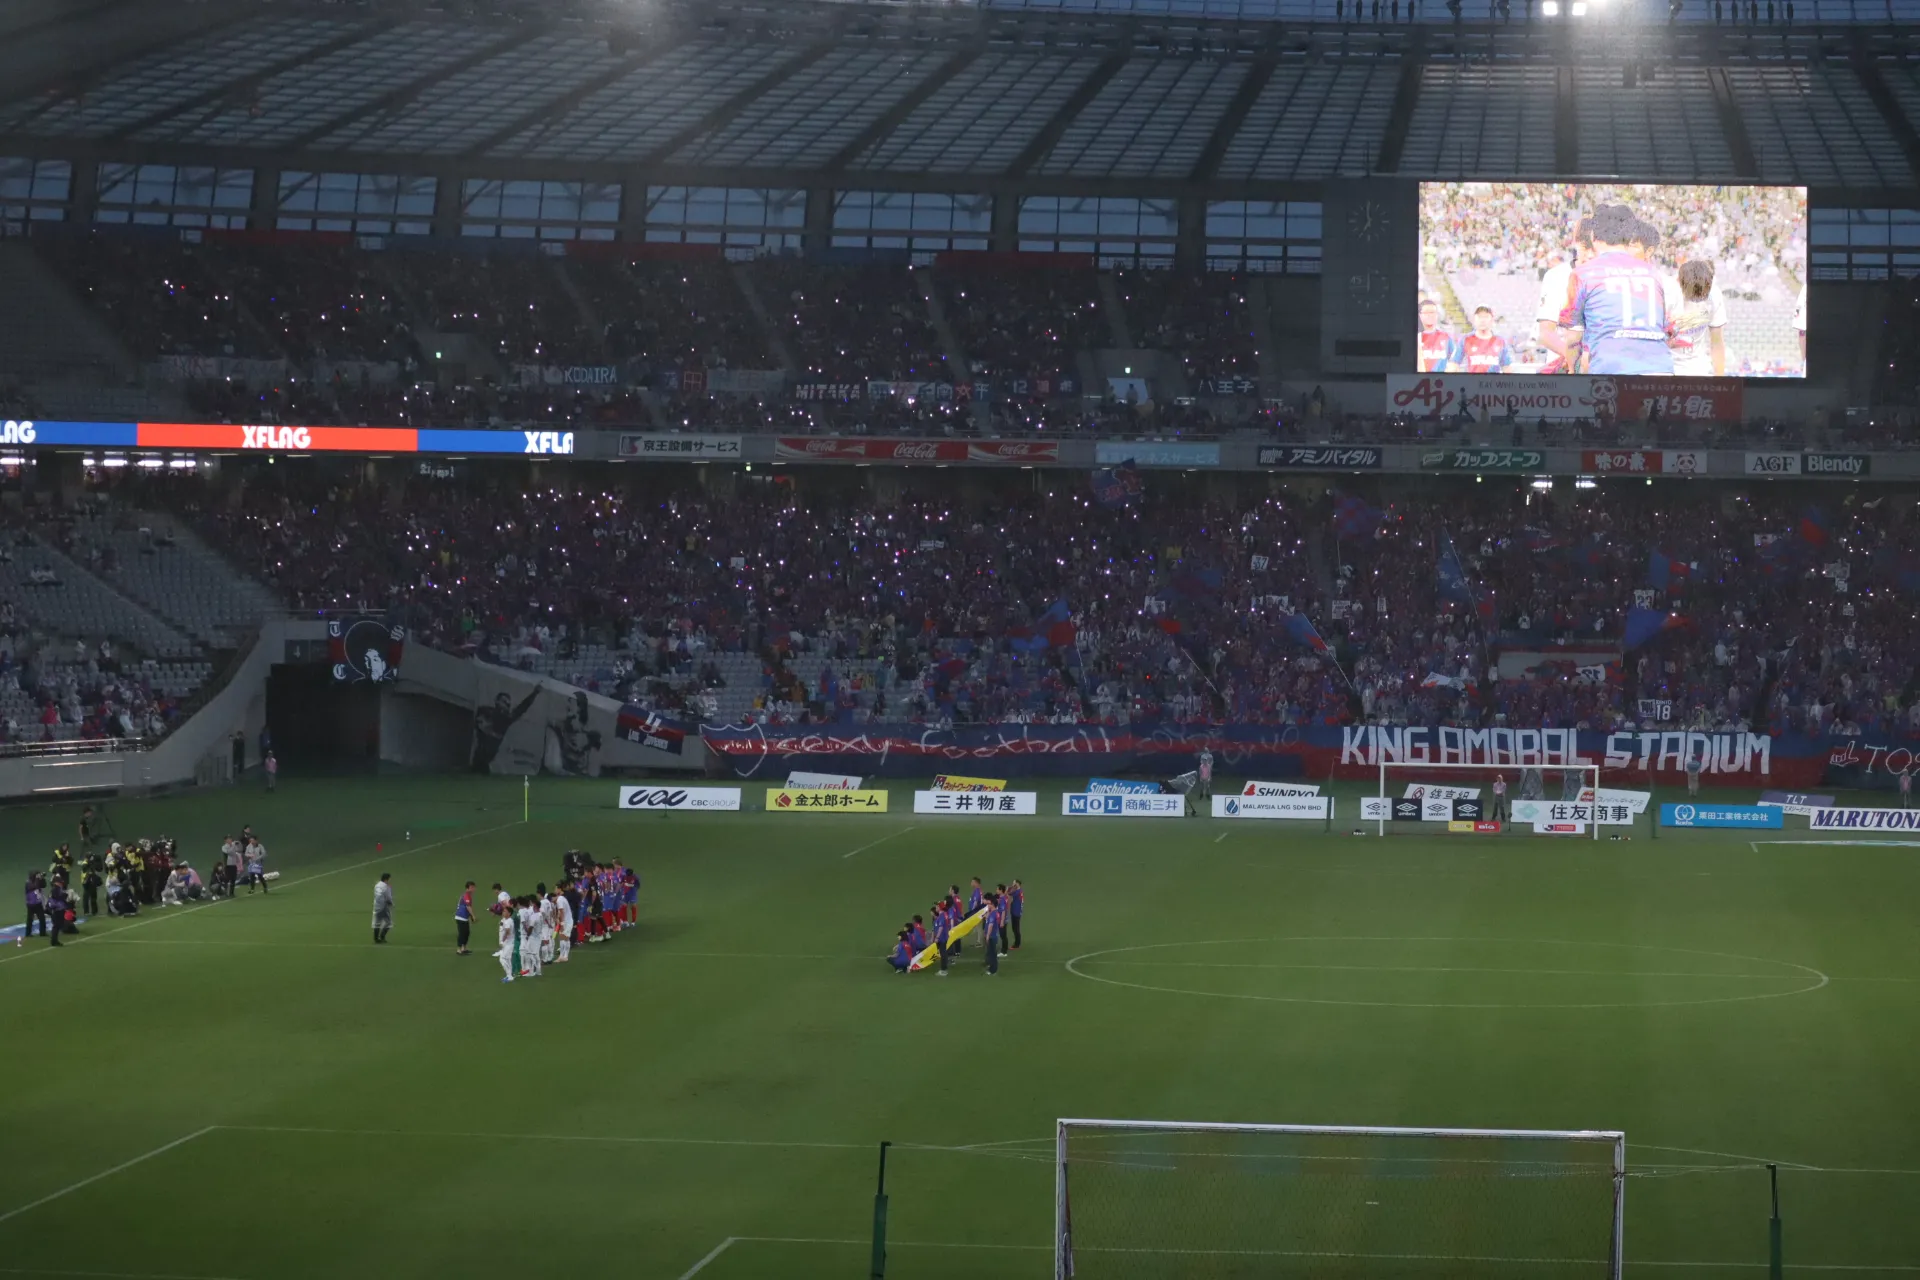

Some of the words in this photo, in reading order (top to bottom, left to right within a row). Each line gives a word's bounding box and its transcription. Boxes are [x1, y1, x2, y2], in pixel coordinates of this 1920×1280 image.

[564, 365, 617, 384] KODAIRA
[242, 425, 311, 449] XFLAG
[643, 440, 739, 452] 京王設備サービス
[893, 443, 938, 458] Coca-Cola
[1289, 449, 1376, 465] アミノバイタル
[1454, 452, 1540, 467] カップスープ
[1594, 452, 1647, 470] 味の素
[1753, 456, 1795, 472] AGF
[1807, 456, 1863, 475] Blendy
[1656, 705, 1671, 721] 18
[1341, 726, 1430, 766] KING
[1438, 726, 1592, 769] AMARAL
[1604, 732, 1771, 775] STADIUM
[1090, 782, 1131, 795] Sunshine
[1257, 787, 1314, 797] SHINRYO
[795, 793, 880, 807] 金太郎ホーム
[934, 794, 1016, 811] 三井物産
[1071, 797, 1120, 811] MOL
[1125, 799, 1178, 811] 商船三井
[1786, 794, 1807, 805] TLT
[1550, 803, 1629, 822] 住友商事
[1698, 811, 1769, 823] 栗田工業株式会社
